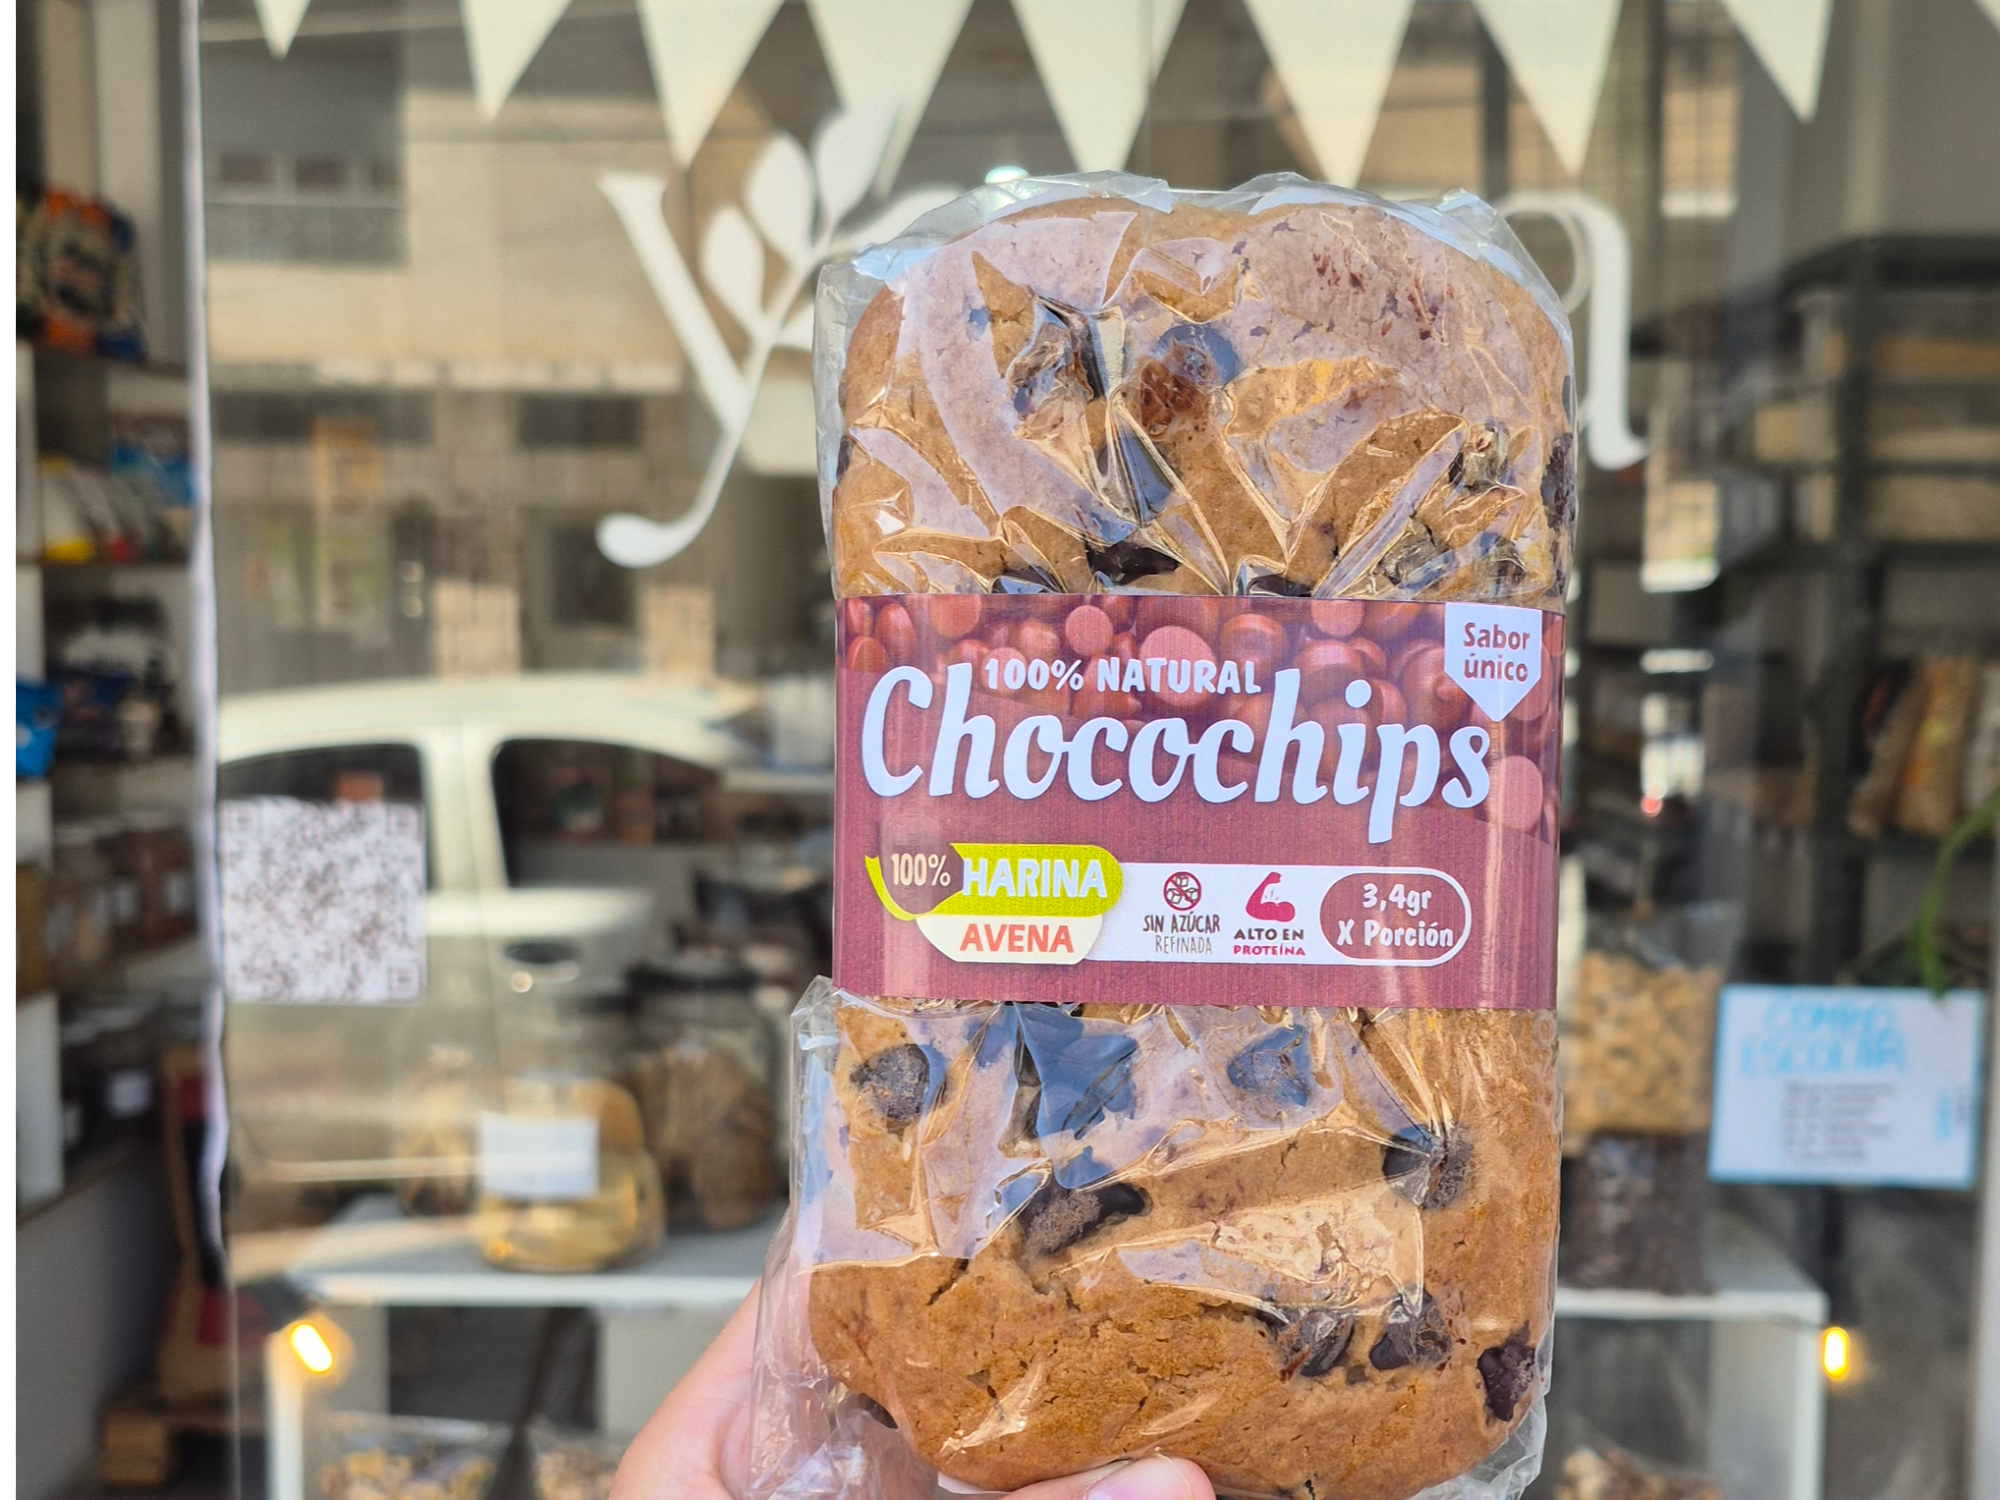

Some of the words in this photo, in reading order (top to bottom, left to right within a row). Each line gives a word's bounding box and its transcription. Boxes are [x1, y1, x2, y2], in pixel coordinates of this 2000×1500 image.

[1462, 622, 1531, 650] Sabor
[984, 658, 1084, 691] 100%
[1096, 656, 1262, 694] NATURAL
[1463, 652, 1529, 683] único
[861, 661, 1491, 845] Chocochips
[890, 853, 951, 887] 100%
[961, 857, 1108, 899] HARINA
[1361, 882, 1432, 917] 3,4gr
[958, 923, 1075, 954] AVENA
[1142, 914, 1165, 934] SIN
[1170, 911, 1221, 935] AZÚCAR
[1233, 927, 1278, 942] ALTO
[1282, 928, 1305, 941] EN
[1336, 919, 1354, 947] X
[1363, 919, 1454, 949] Porción
[1154, 935, 1213, 956] REFINADA
[1232, 942, 1306, 957] PROTEÍNA
